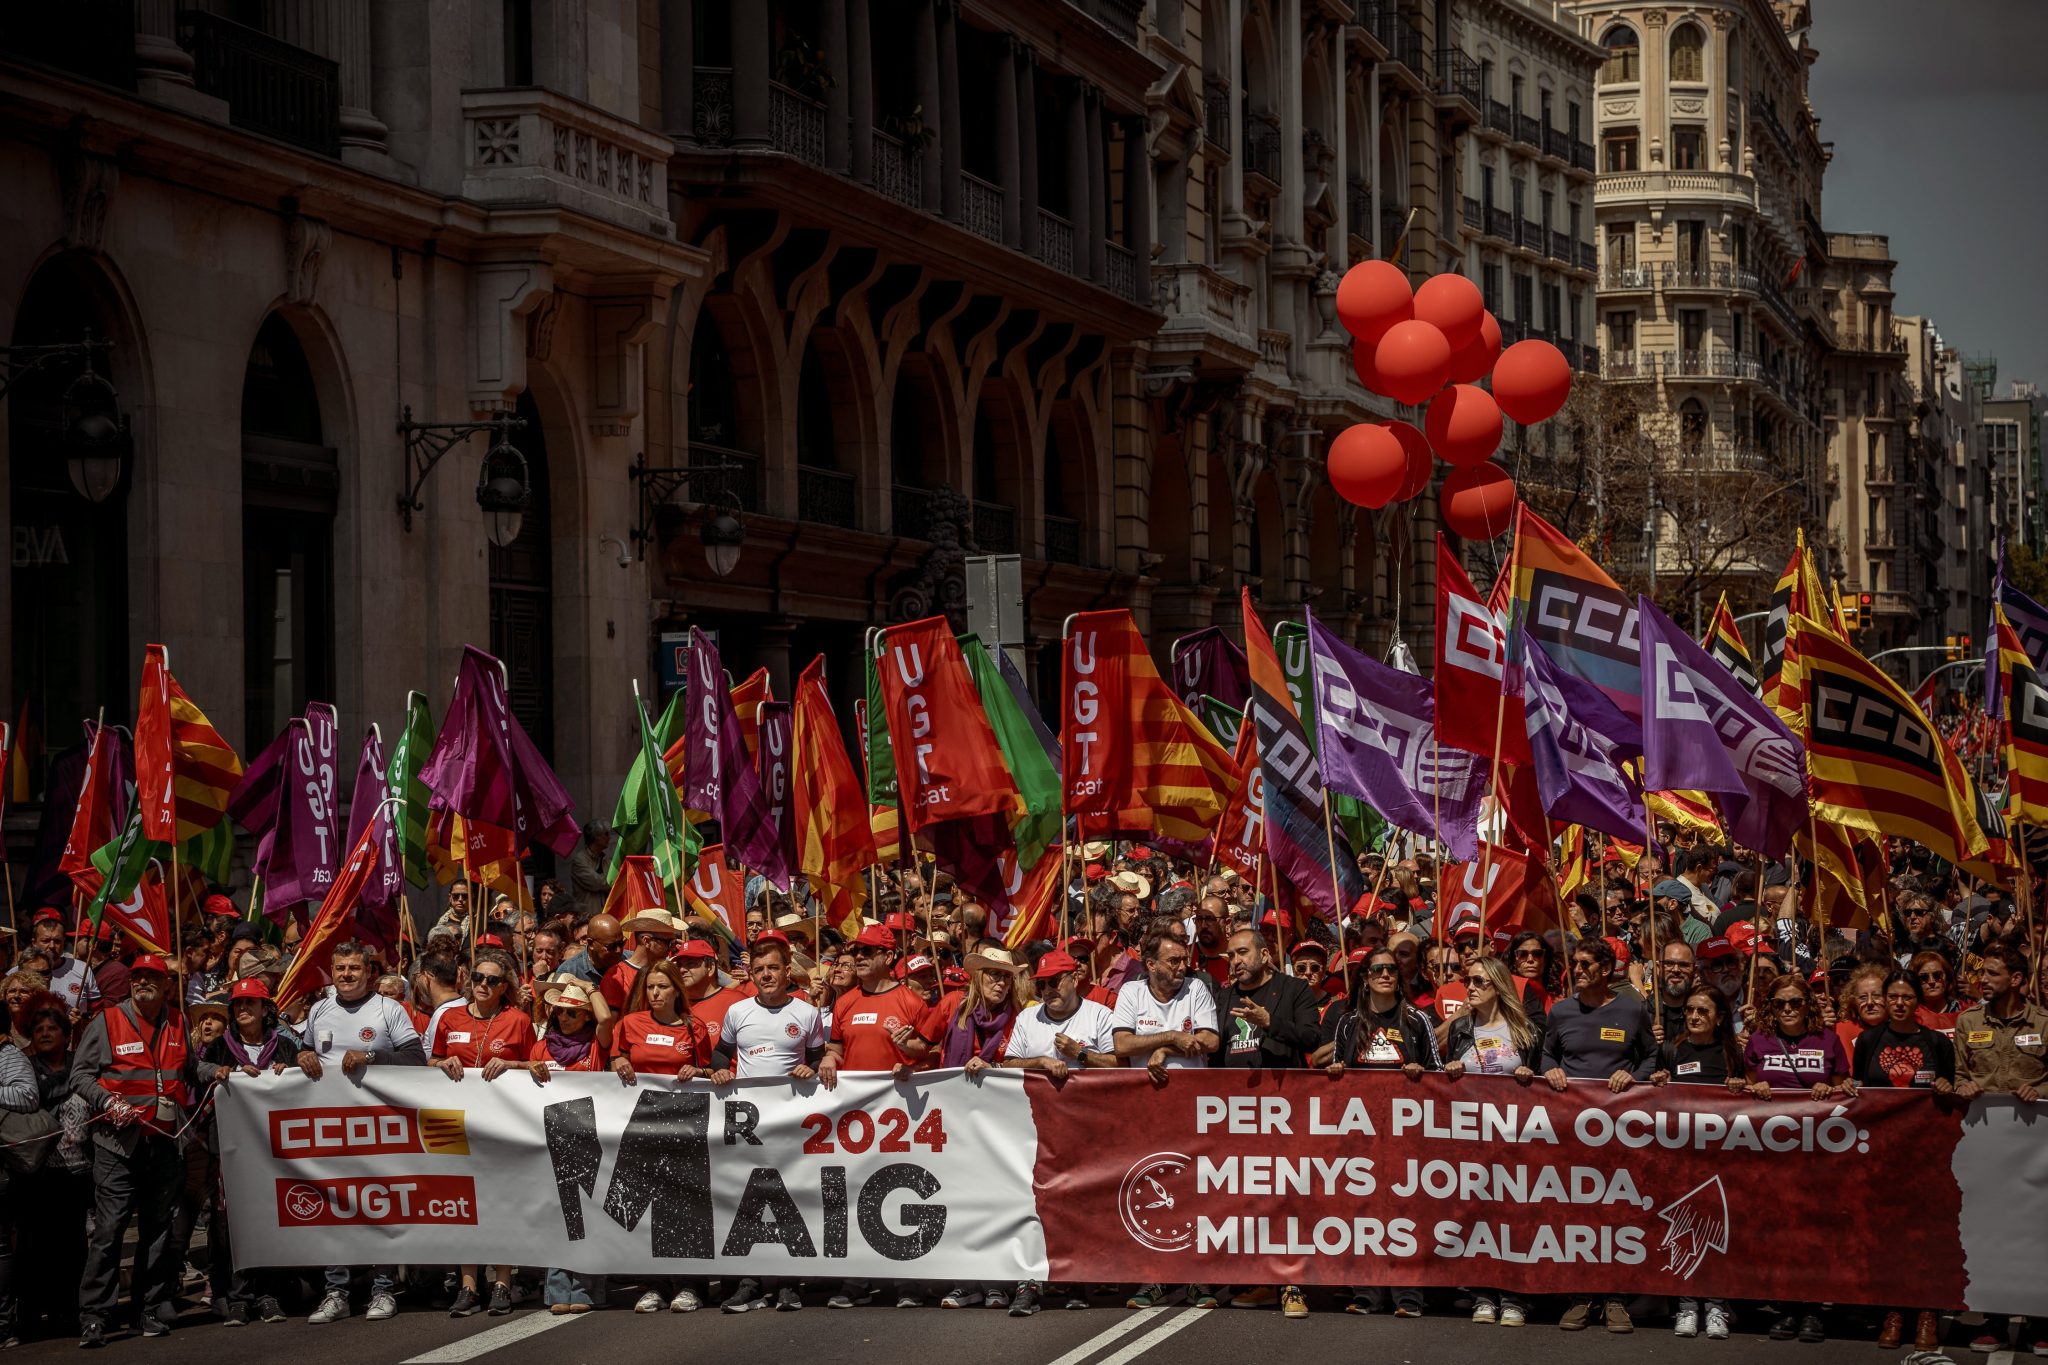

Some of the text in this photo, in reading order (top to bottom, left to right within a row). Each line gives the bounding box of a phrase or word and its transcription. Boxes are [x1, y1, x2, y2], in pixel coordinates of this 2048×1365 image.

[894, 642, 933, 786] UGT
[1073, 631, 1099, 775] UGT
[1817, 685, 1940, 765] CCO
[766, 719, 785, 833] UGT
[916, 785, 951, 809] .cat
[1069, 778, 1103, 796] .cat
[1228, 847, 1259, 871] .cat
[280, 1115, 409, 1149] CCOO
[803, 1108, 947, 1154] 2024
[1196, 1096, 1869, 1154] PER LA PLENA OCUPACIÓ:
[327, 1182, 470, 1219] UGT.cat
[1196, 1156, 1654, 1211] MENYS JORNADA,
[1196, 1215, 1646, 1265] MILLORS SALARIS
